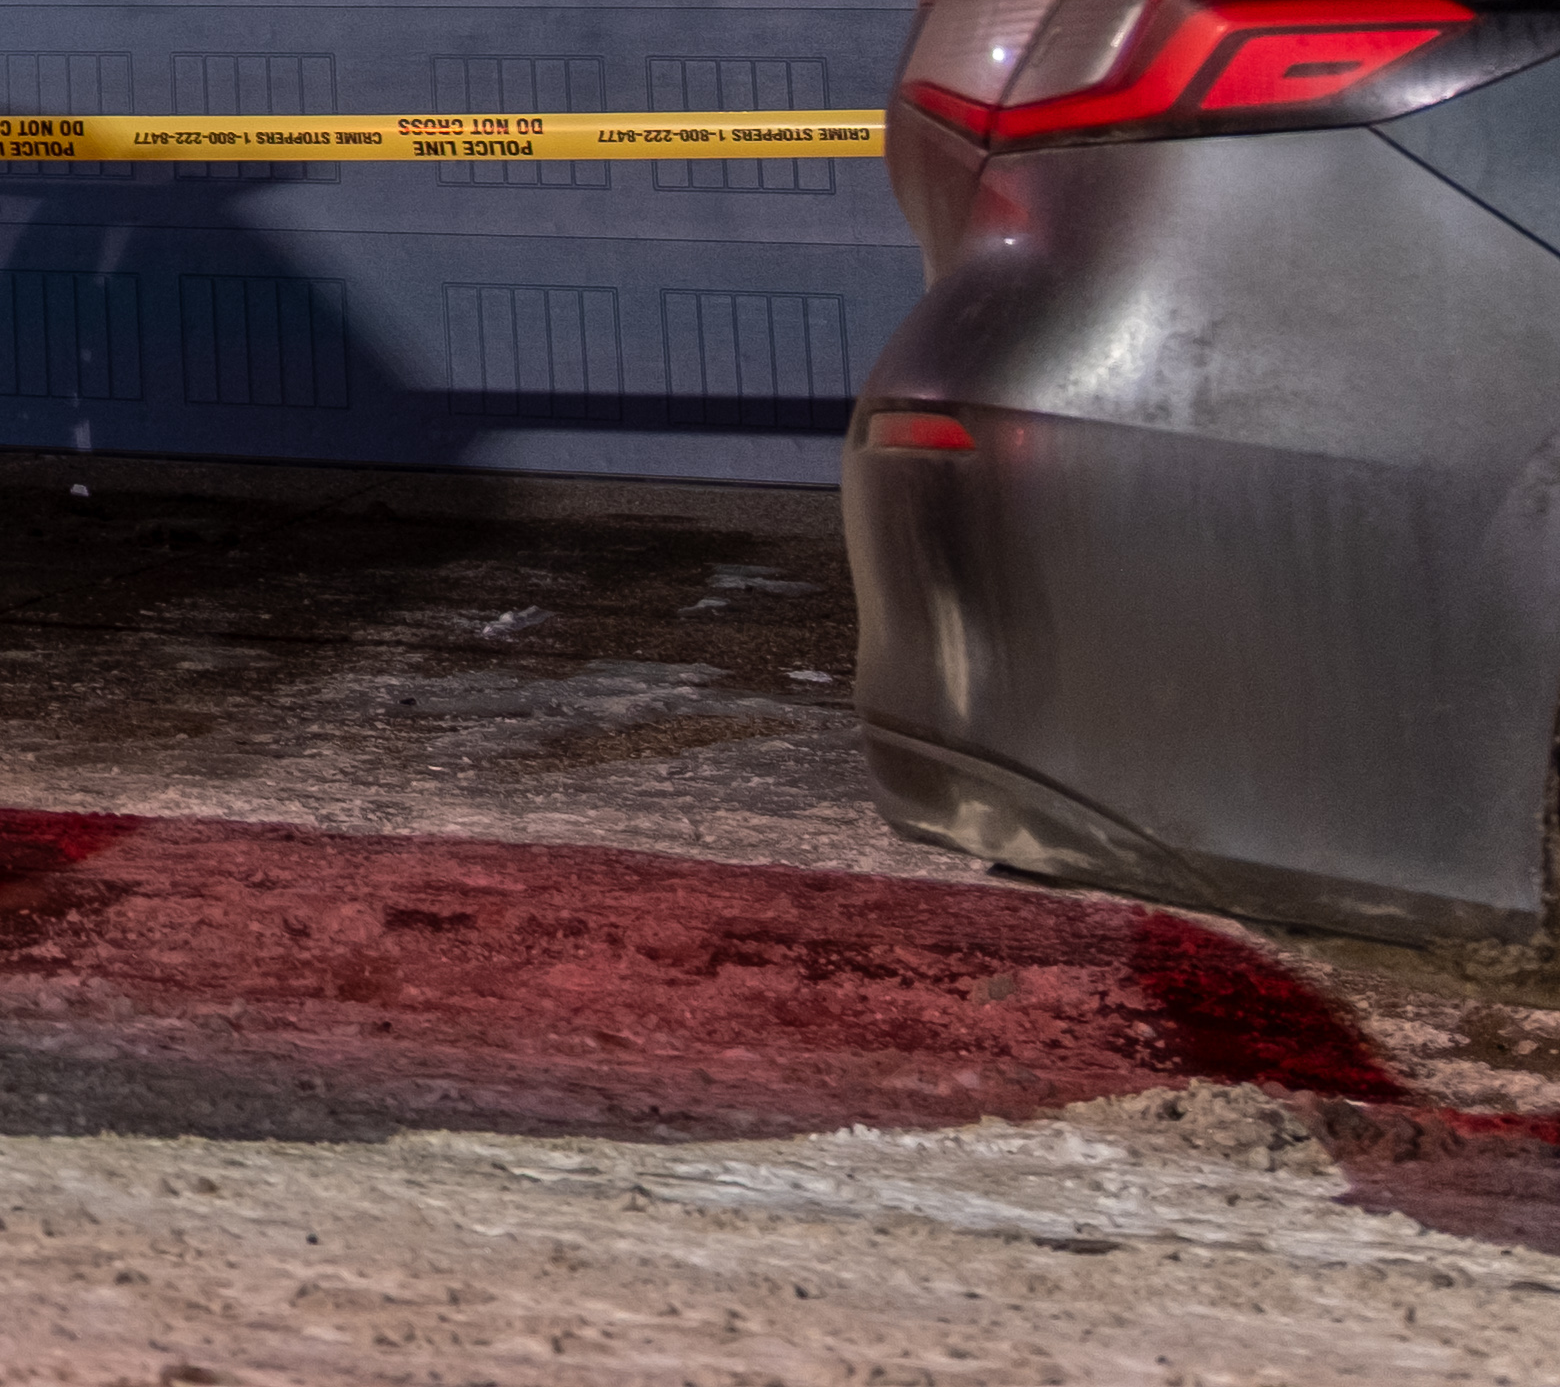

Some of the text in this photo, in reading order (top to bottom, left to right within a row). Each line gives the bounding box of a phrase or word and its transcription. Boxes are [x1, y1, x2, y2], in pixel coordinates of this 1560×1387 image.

[17, 119, 54, 138] NOT
[59, 119, 85, 137] DO
[397, 117, 544, 136] DO NOT CROSS
[597, 127, 871, 144] CRIME STOPPERS 1-800-222-8477
[133, 131, 383, 145] CRIME STOPPERS 1-800-222-8477
[9, 140, 76, 158] POLICE
[412, 139, 534, 157] POLICE LINE
